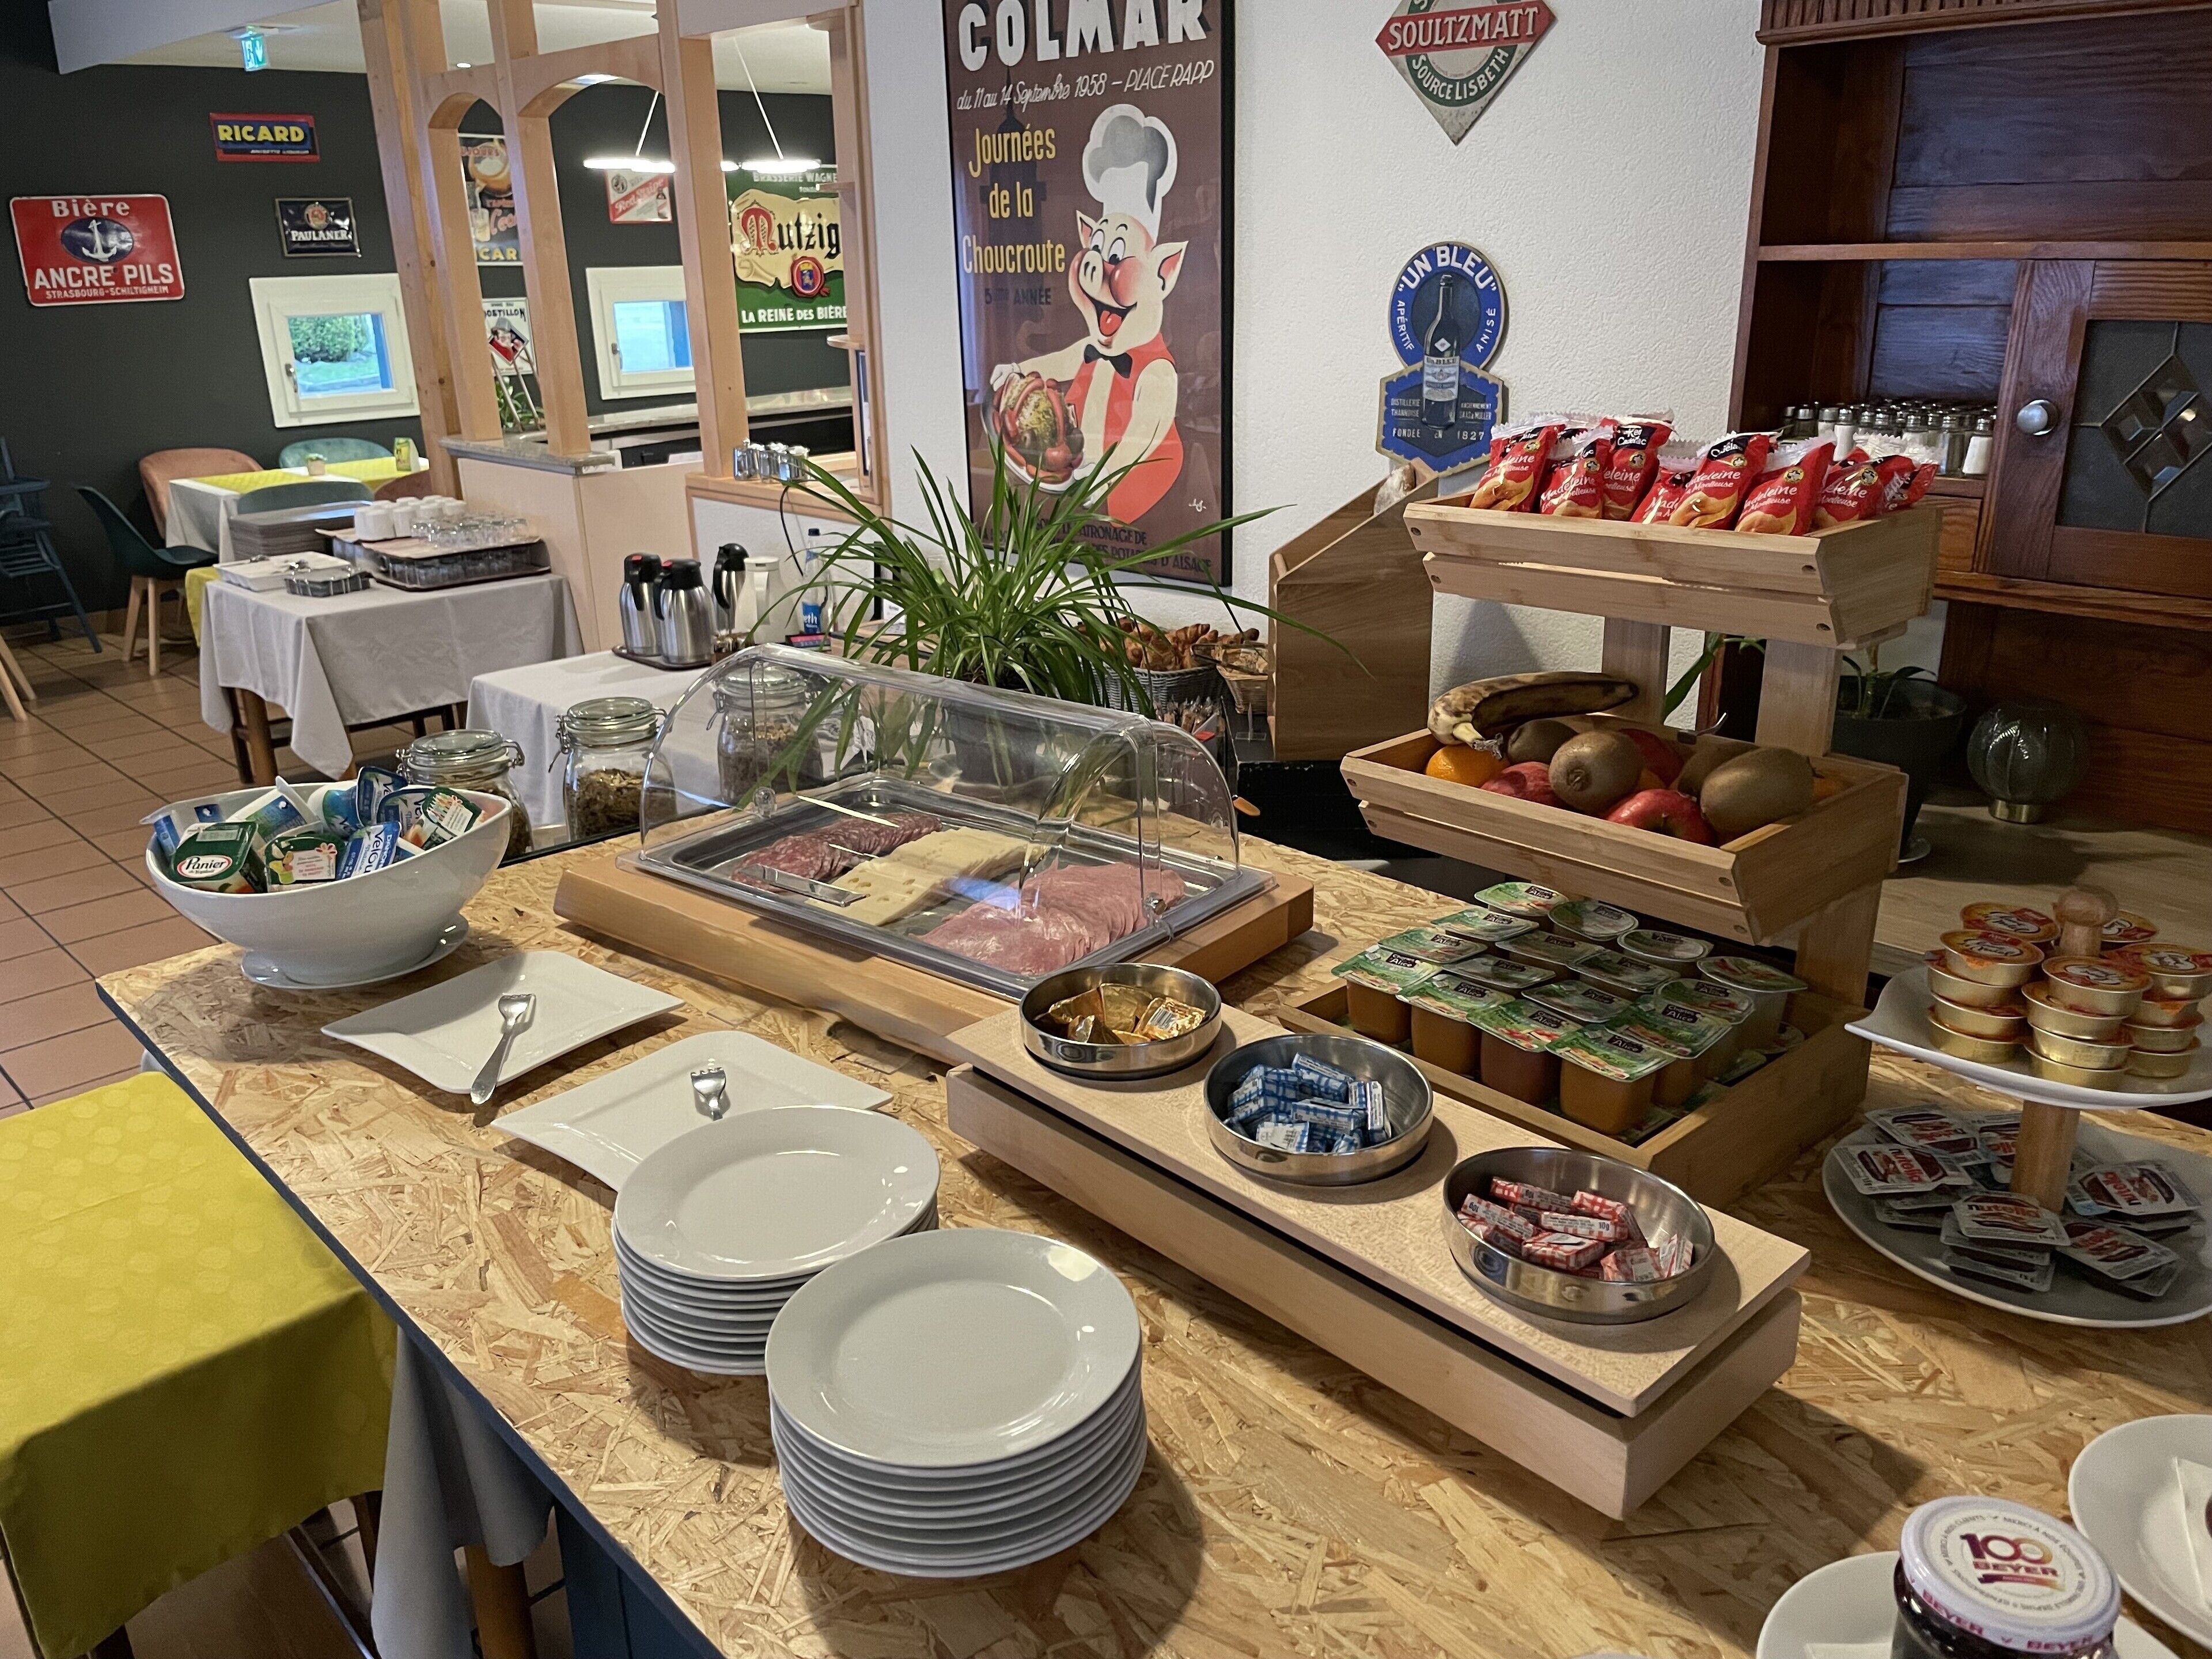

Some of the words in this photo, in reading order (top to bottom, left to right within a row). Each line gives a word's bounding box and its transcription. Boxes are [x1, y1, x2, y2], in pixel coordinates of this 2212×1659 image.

[958, 0, 1207, 72] COLMAR
[1387, 7, 1539, 51] SOULTZMATT
[1412, 54, 1452, 100] SOURCE
[1455, 48, 1509, 100] LISBETH
[956, 89, 972, 110] du
[983, 93, 997, 108] au
[1001, 84, 1013, 106] 14
[1013, 73, 1071, 113] Septembre
[1074, 73, 1107, 98] 1958
[1124, 62, 1172, 92] PLACE
[1169, 59, 1215, 88] RAPP
[218, 125, 305, 142] RICARD
[968, 123, 1056, 179] Journées
[753, 172, 804, 183] BRASSERIE
[52, 199, 130, 217] Bière
[988, 182, 1010, 219] de
[1016, 181, 1034, 218] la
[290, 230, 349, 241] PAULANER
[740, 201, 841, 259] Mutzig
[472, 247, 517, 260] CAR
[962, 234, 1066, 274] Choucroute
[34, 265, 116, 289] ANCRE
[123, 263, 174, 285] PILS
[741, 309, 755, 324] LA
[757, 308, 794, 323] REINE
[796, 309, 814, 320] DES
[1396, 300, 1415, 351] APÉRITIF
[1475, 307, 1497, 353] ANISÉ
[1457, 431, 1485, 441] 1827
[1685, 470, 1741, 489] adeleine
[1079, 524, 1134, 544] ATRONAGE
[1133, 531, 1147, 545] DE
[185, 857, 226, 871] Panier
[1389, 957, 1413, 968] Alice
[1457, 987, 1482, 997] Alice
[1532, 1016, 1557, 1028] Alice
[1666, 1010, 1693, 1022] Alice
[1612, 1039, 1638, 1052] Alice
[1967, 1204, 2041, 1219] nutella
[1598, 1221, 1611, 1232] 10g
[1960, 1532, 2054, 1566] 100
[1972, 1560, 2059, 1578] BEYER
[1922, 1589, 1984, 1636] BEYER
[2026, 1634, 2094, 1652] BEYER
